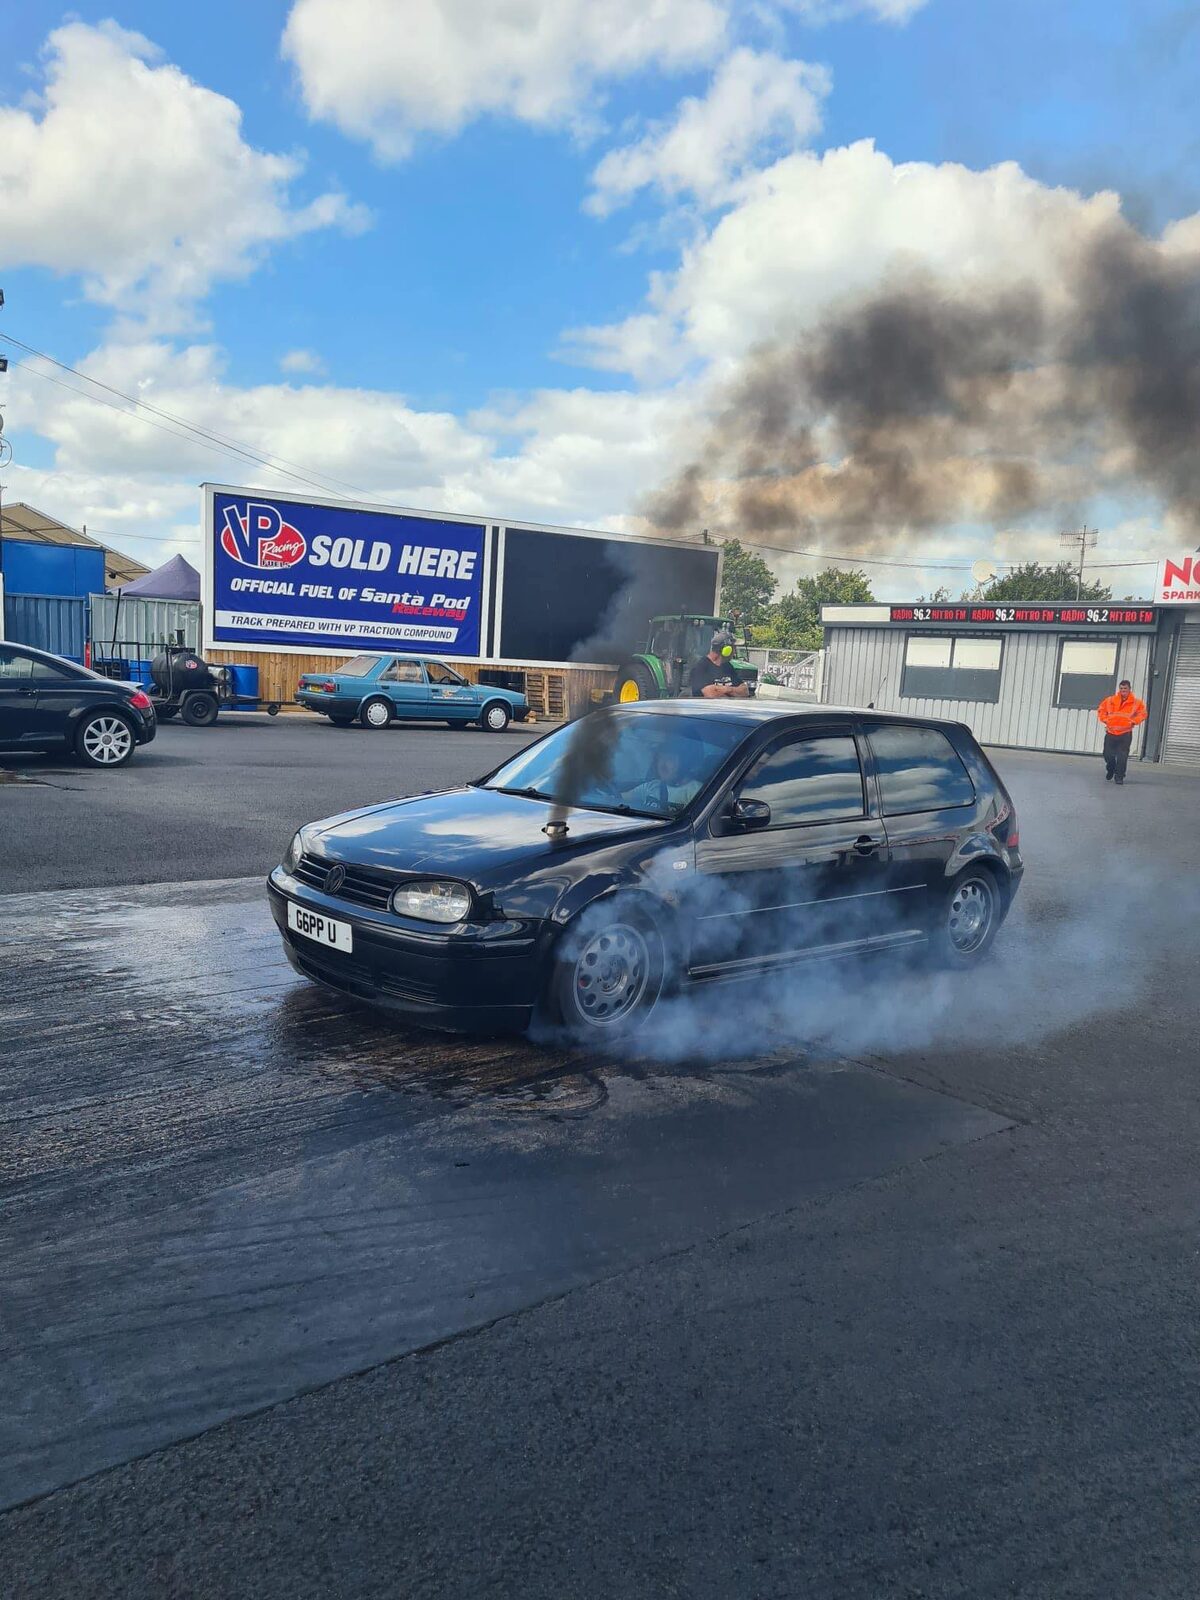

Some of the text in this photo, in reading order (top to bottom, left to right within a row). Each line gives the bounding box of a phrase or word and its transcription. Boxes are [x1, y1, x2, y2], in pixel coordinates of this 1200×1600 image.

[222, 502, 282, 568] VP
[262, 540, 304, 559] Racing
[308, 535, 477, 580] SOLD HERE
[1163, 557, 1200, 587] N
[230, 577, 471, 610] OFFICIAL FUEL OF Santa Pod
[392, 602, 467, 621] Raceway
[892, 608, 966, 621] RADIO 96.2 NITRO FM
[972, 608, 1054, 621] RADIO 96.2 NITRO FM
[1061, 609, 1153, 623] RADIO 96.2 NITRO FM
[231, 615, 452, 639] TRACK PREPARED WITH VP TRACTION COMPOUND
[296, 909, 337, 944] G6PP U
